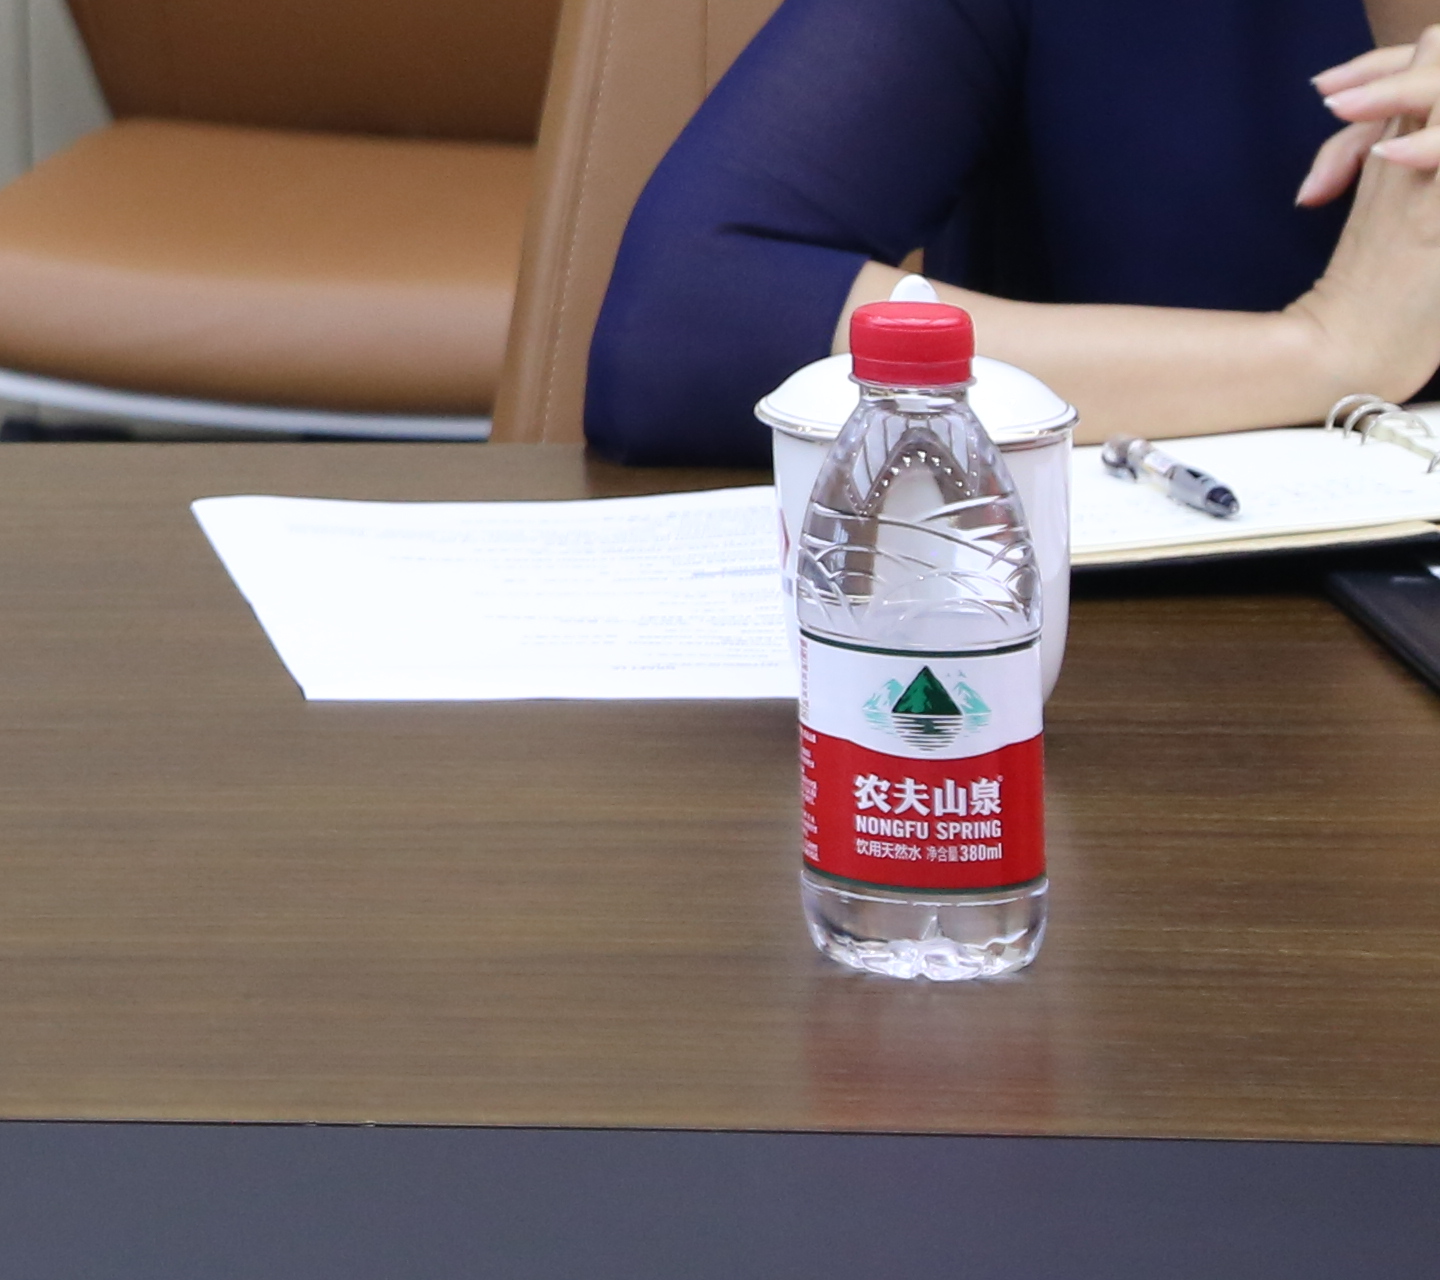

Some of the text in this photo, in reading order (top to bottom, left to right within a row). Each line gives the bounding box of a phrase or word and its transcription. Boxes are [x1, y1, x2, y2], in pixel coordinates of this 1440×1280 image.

[854, 774, 1002, 817] 农夫山泉
[855, 814, 1002, 840] NONGFU SPRING
[856, 838, 922, 861] 饮用天然水
